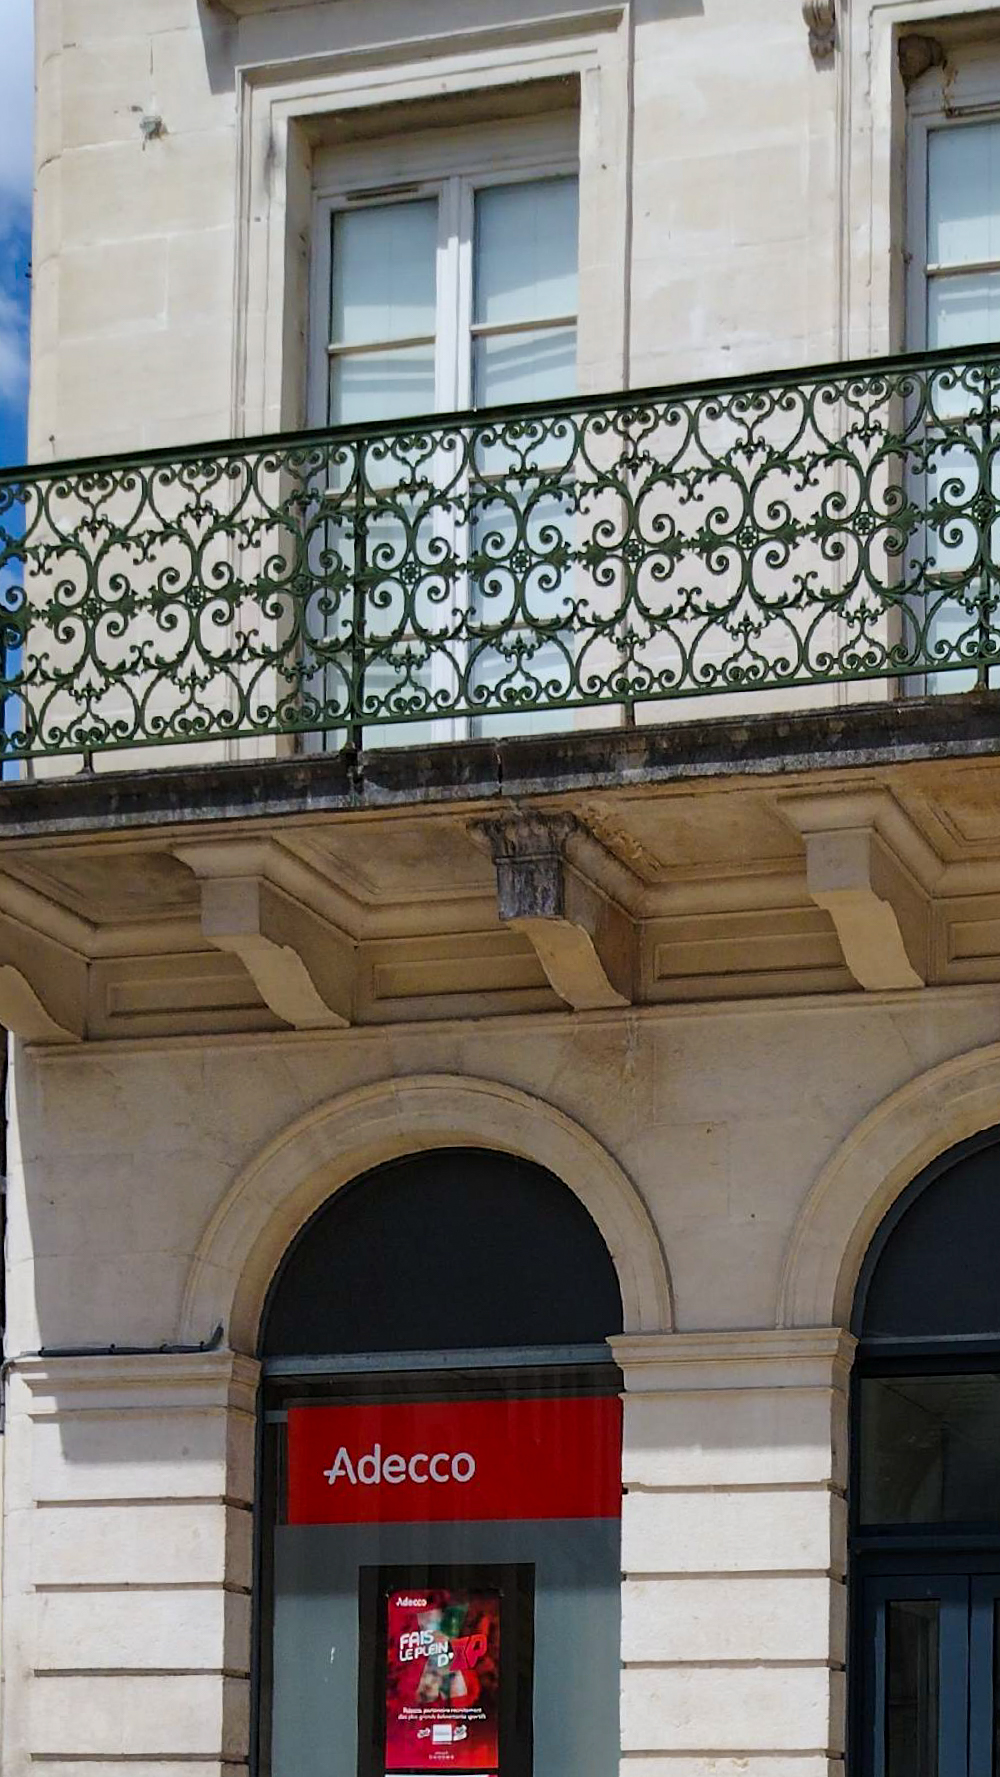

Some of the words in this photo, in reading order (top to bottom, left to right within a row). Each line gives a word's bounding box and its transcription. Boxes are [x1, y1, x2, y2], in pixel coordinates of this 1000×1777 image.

[324, 1443, 476, 1485] Adecco
[396, 1596, 427, 1607] Adecco
[400, 1630, 435, 1650] FAIS
[400, 1648, 414, 1661] LE
